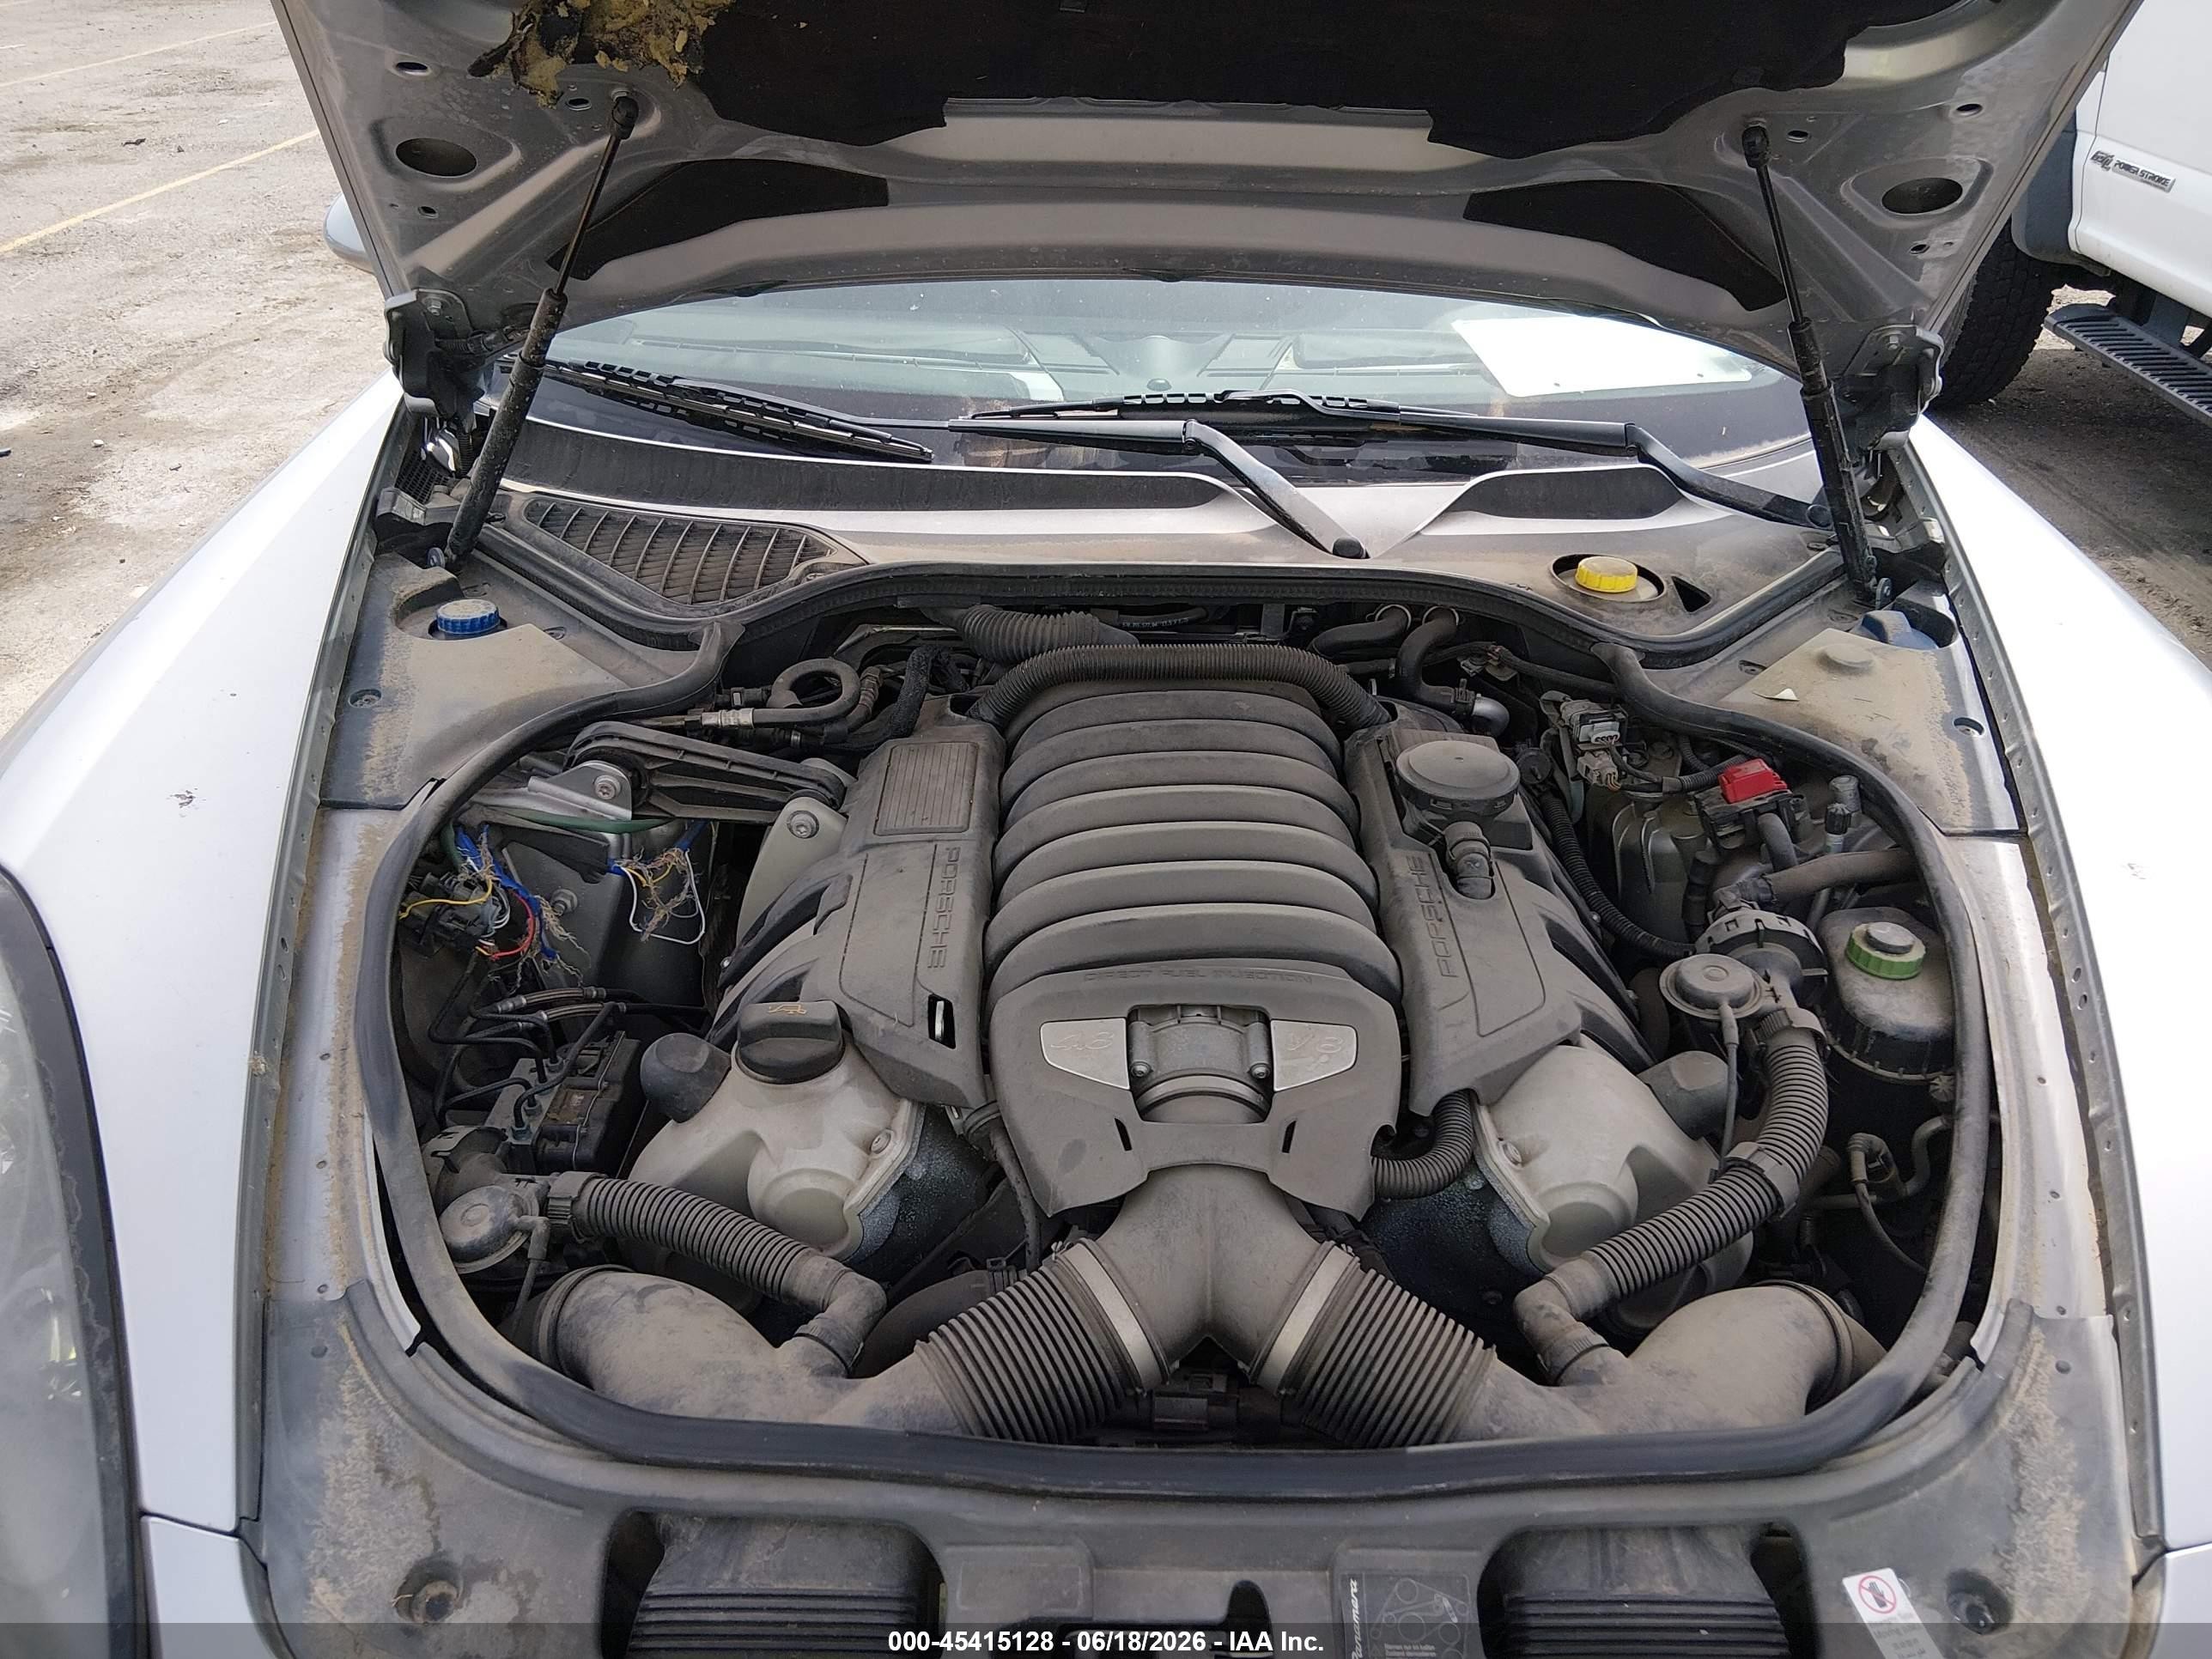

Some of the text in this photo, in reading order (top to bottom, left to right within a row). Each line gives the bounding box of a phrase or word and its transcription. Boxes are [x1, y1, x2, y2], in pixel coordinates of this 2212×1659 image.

[2114, 160, 2140, 175] POWER
[2139, 169, 2172, 186] STROKE
[927, 847, 961, 969] PORSCHE
[1406, 855, 1458, 978] PORSCHE
